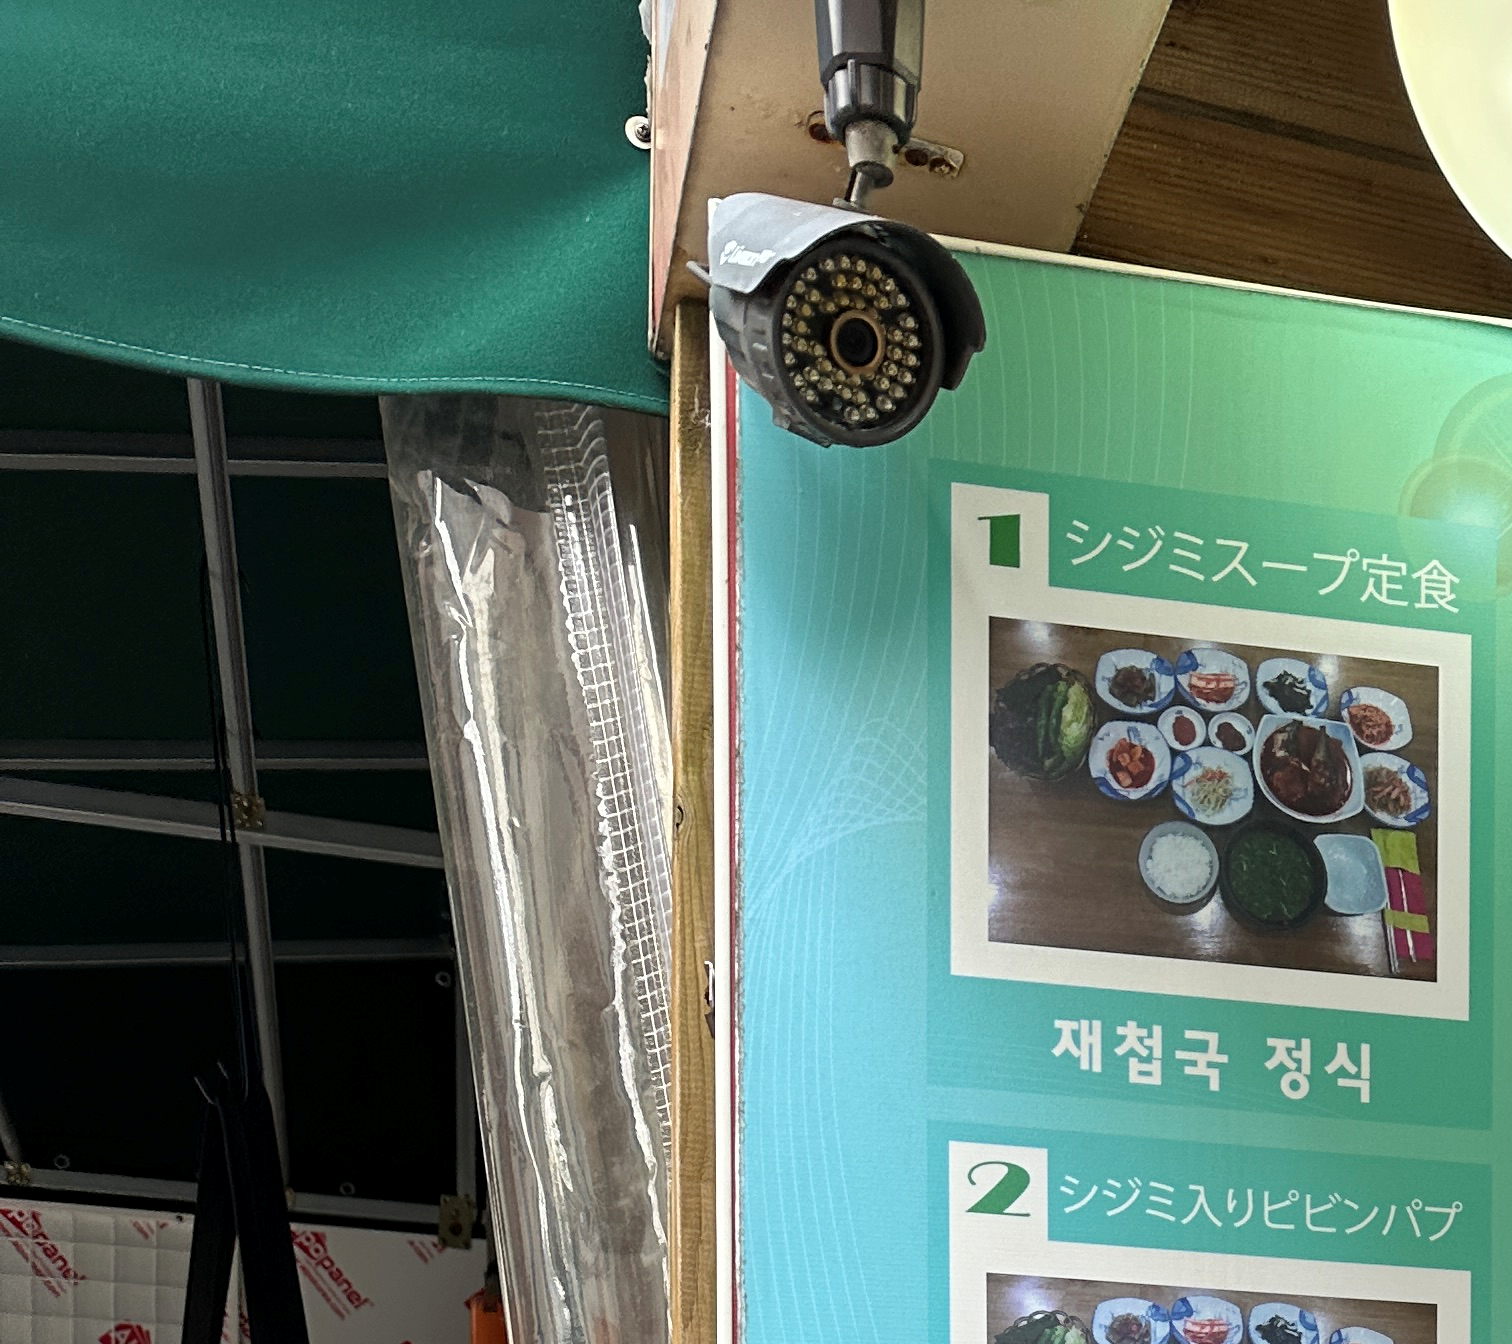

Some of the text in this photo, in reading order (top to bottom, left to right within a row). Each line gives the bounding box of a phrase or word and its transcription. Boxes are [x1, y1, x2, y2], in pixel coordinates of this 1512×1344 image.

[978, 514, 1460, 614] 1 シジミスープ定食
[1052, 1018, 1370, 1103] 재첩국 정식
[966, 1161, 1463, 1241] 2 シジミ入りピビンパプ
